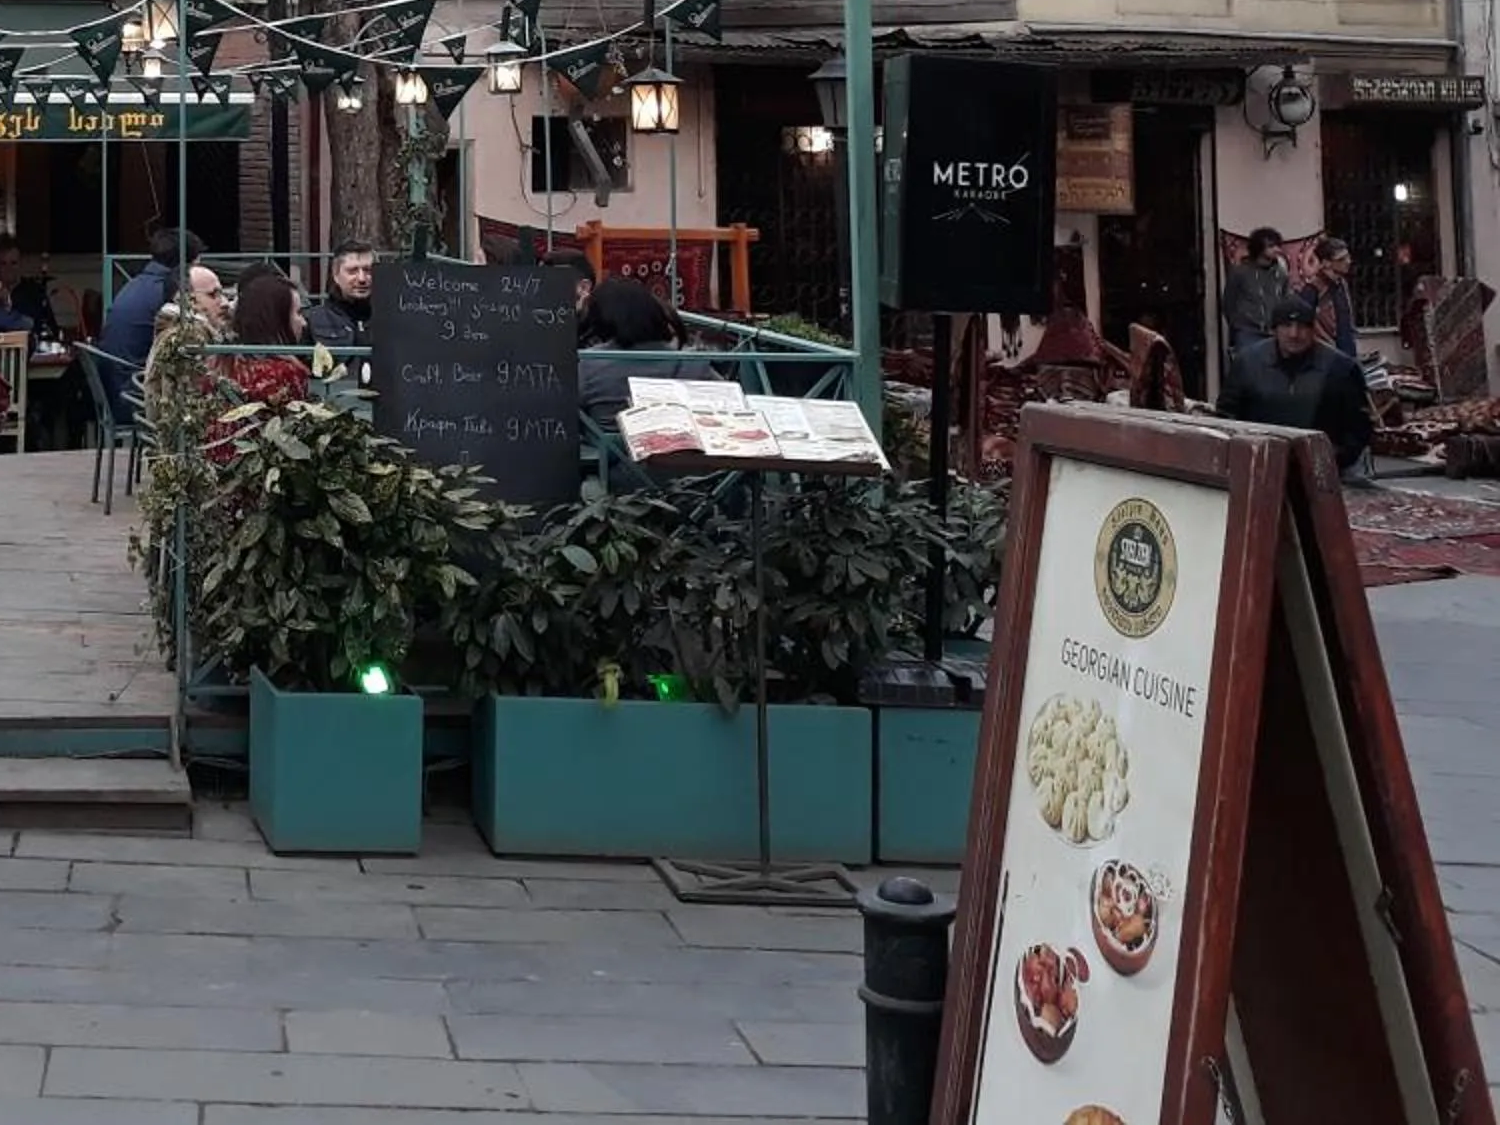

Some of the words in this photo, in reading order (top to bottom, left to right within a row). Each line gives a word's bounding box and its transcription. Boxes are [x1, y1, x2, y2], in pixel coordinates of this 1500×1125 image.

[933, 161, 1028, 188] METRO
[403, 269, 480, 293] Welcome
[500, 273, 541, 296] 24/7
[1060, 637, 1131, 692] GEORGIAN
[1132, 666, 1197, 719] CUISINE
